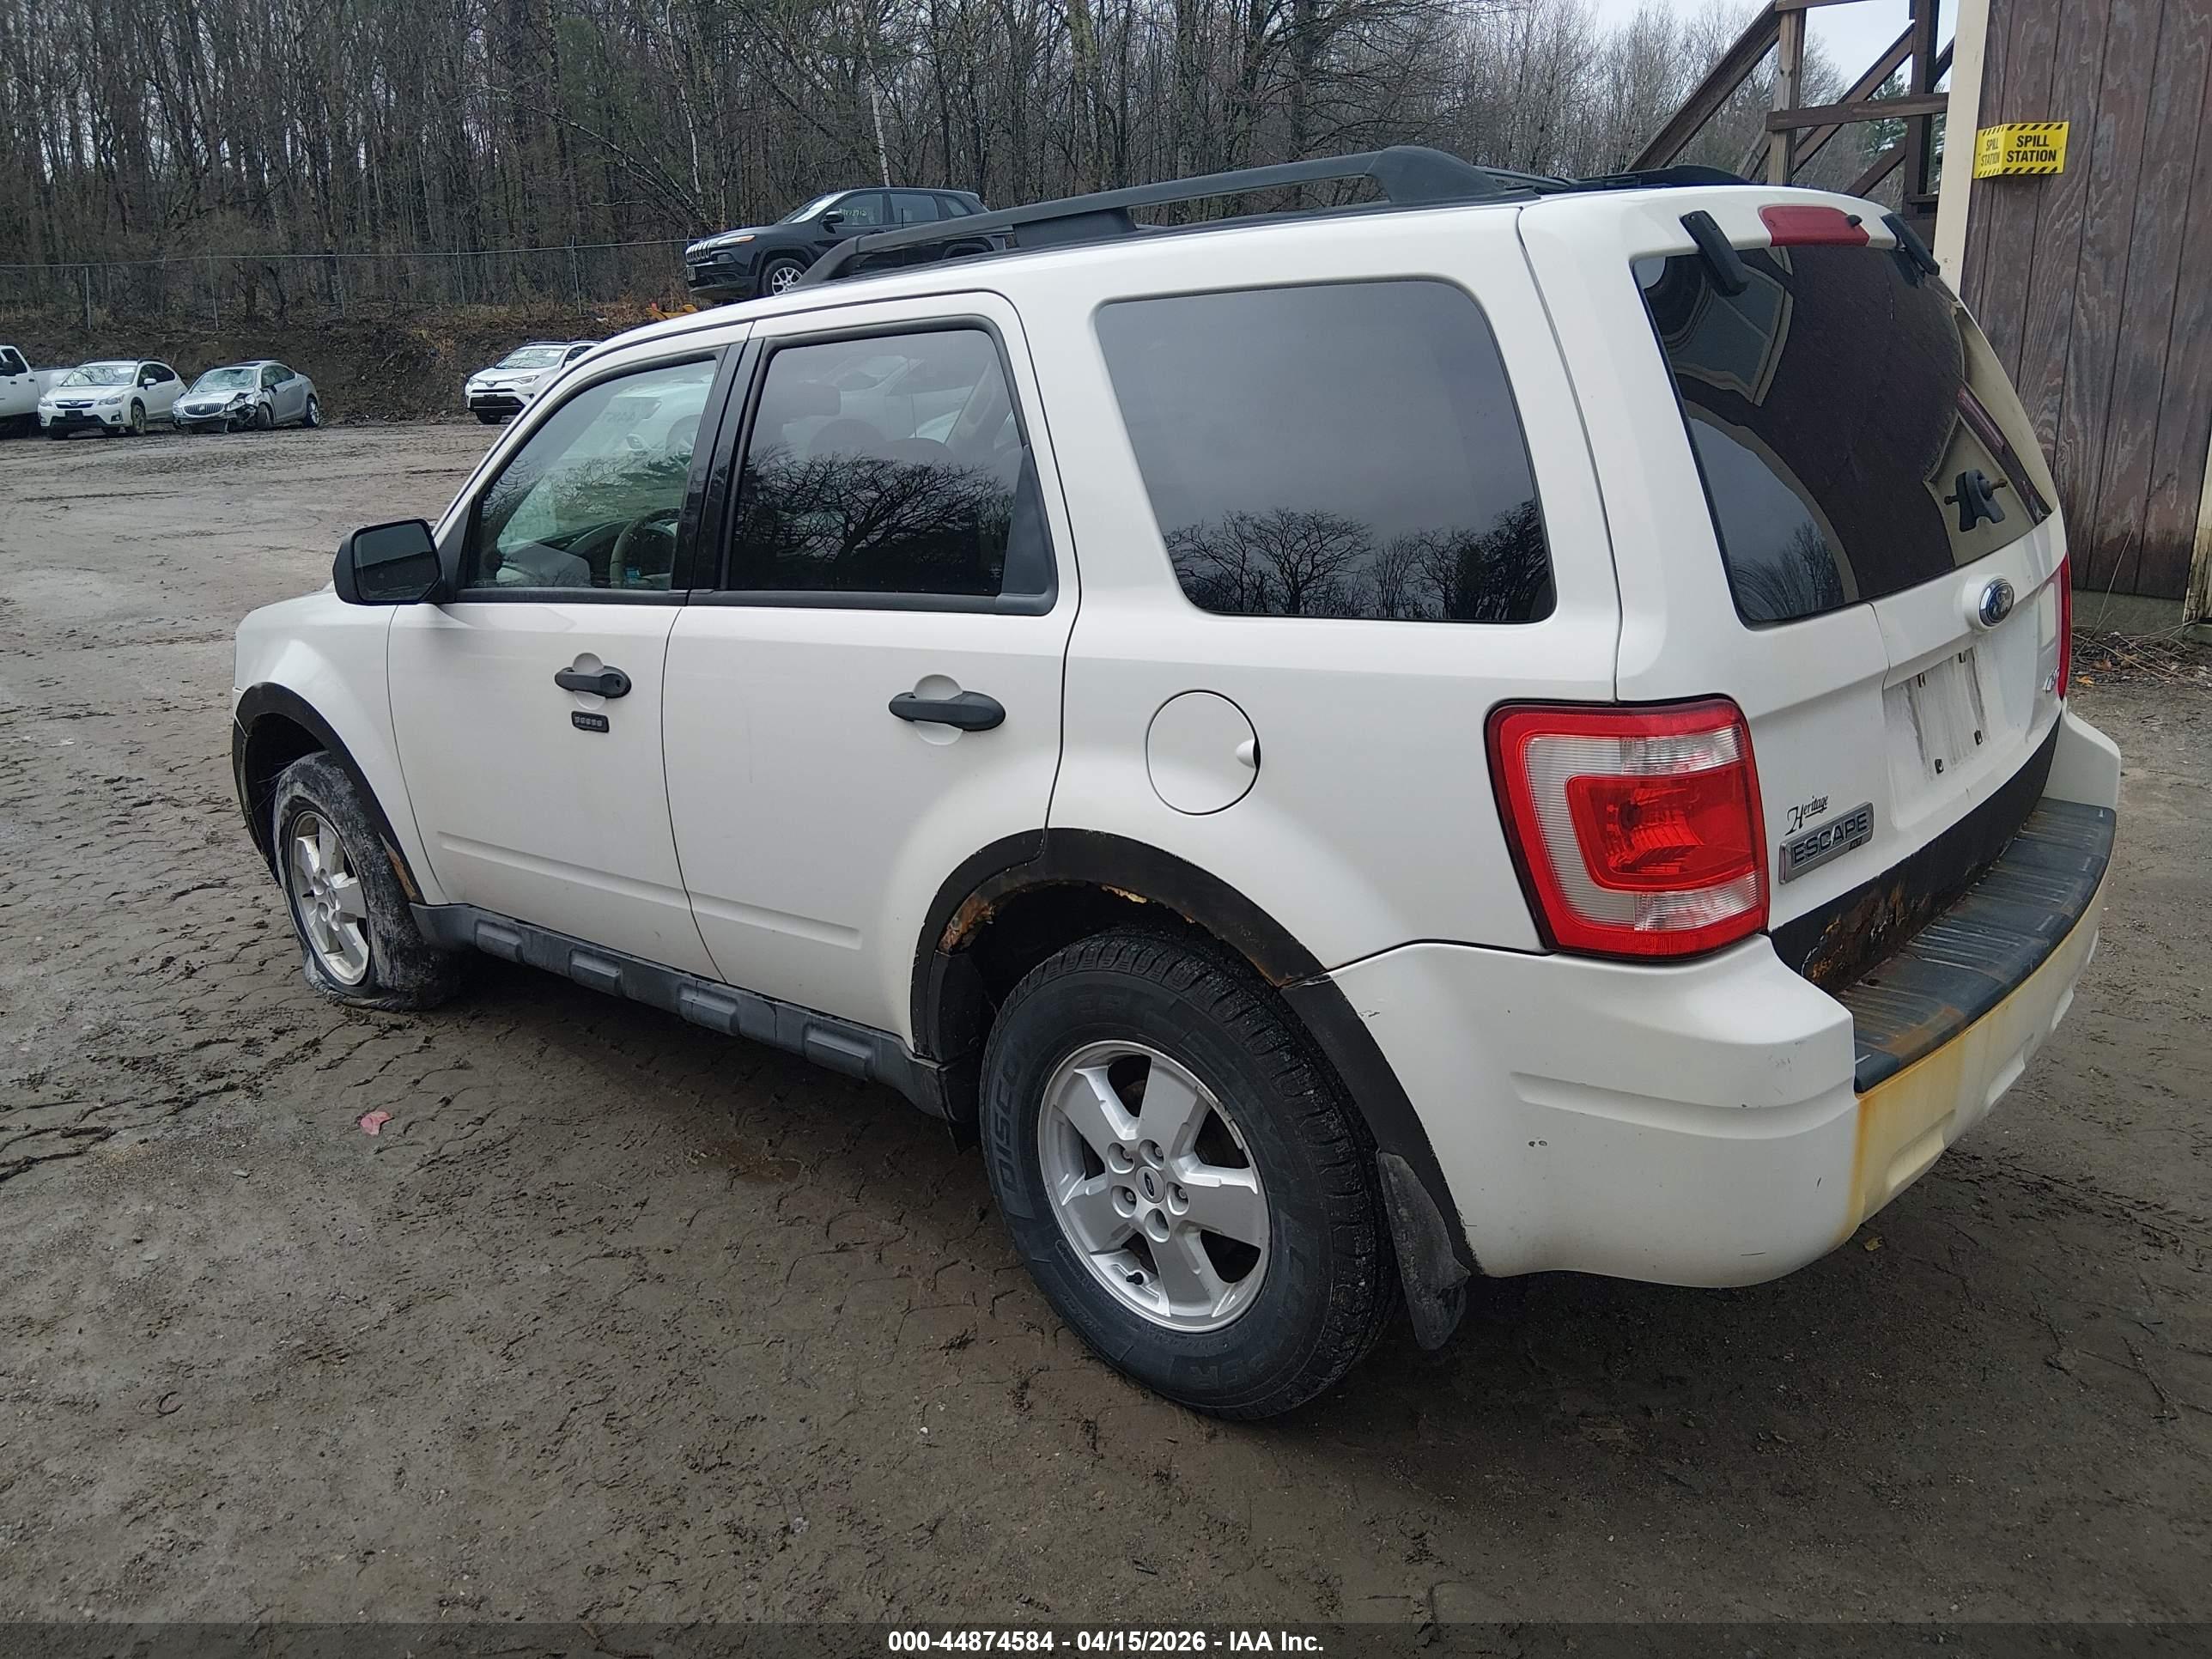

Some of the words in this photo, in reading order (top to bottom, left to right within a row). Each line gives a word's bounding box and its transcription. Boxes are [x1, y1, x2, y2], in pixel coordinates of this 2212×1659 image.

[1985, 137, 1999, 151] SPILL
[2016, 135, 2050, 148] SPILL
[1980, 152, 2000, 167] STATION
[2006, 149, 2057, 162] STATION
[1785, 795, 1829, 836] Heritage
[1793, 811, 1869, 864] ESCAPE
